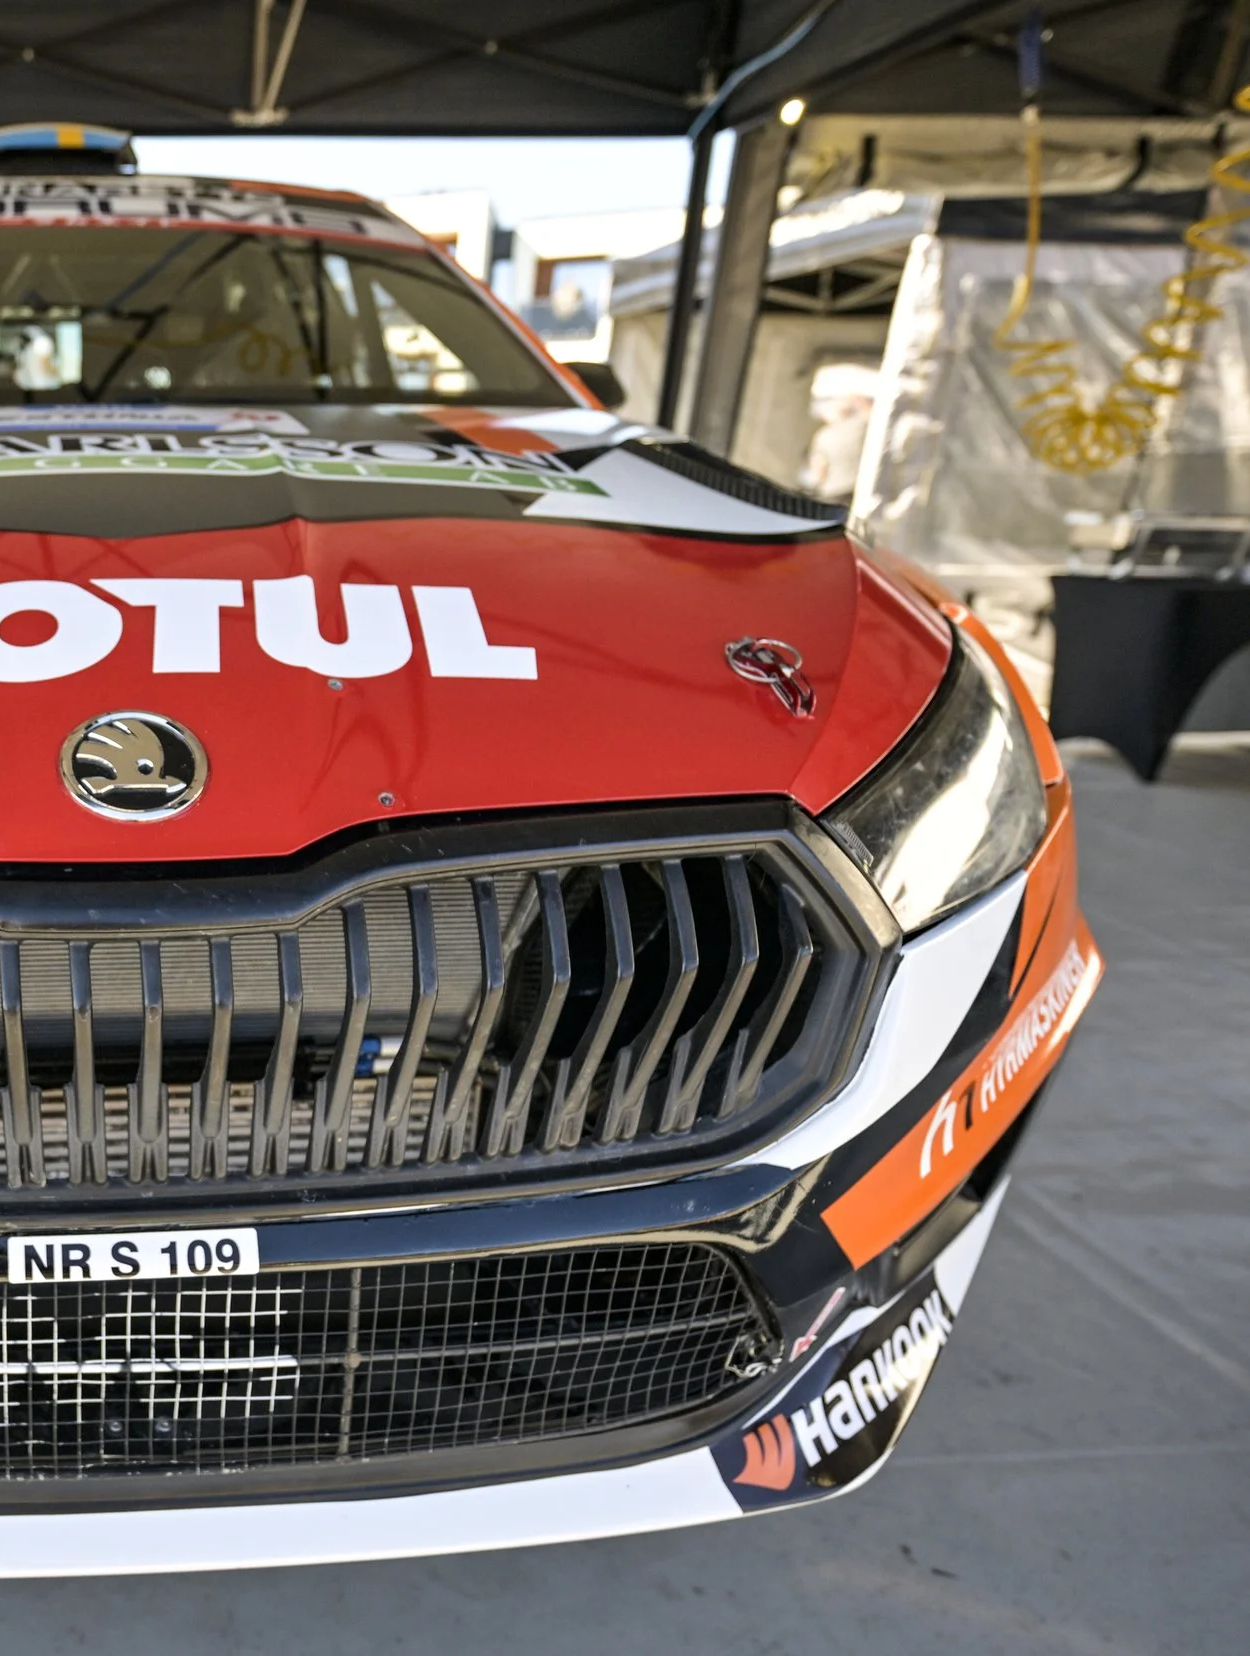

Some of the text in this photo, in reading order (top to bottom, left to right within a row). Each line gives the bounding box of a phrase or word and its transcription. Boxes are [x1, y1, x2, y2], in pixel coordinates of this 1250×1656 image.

[24, 1238, 241, 1281] NR S 109
